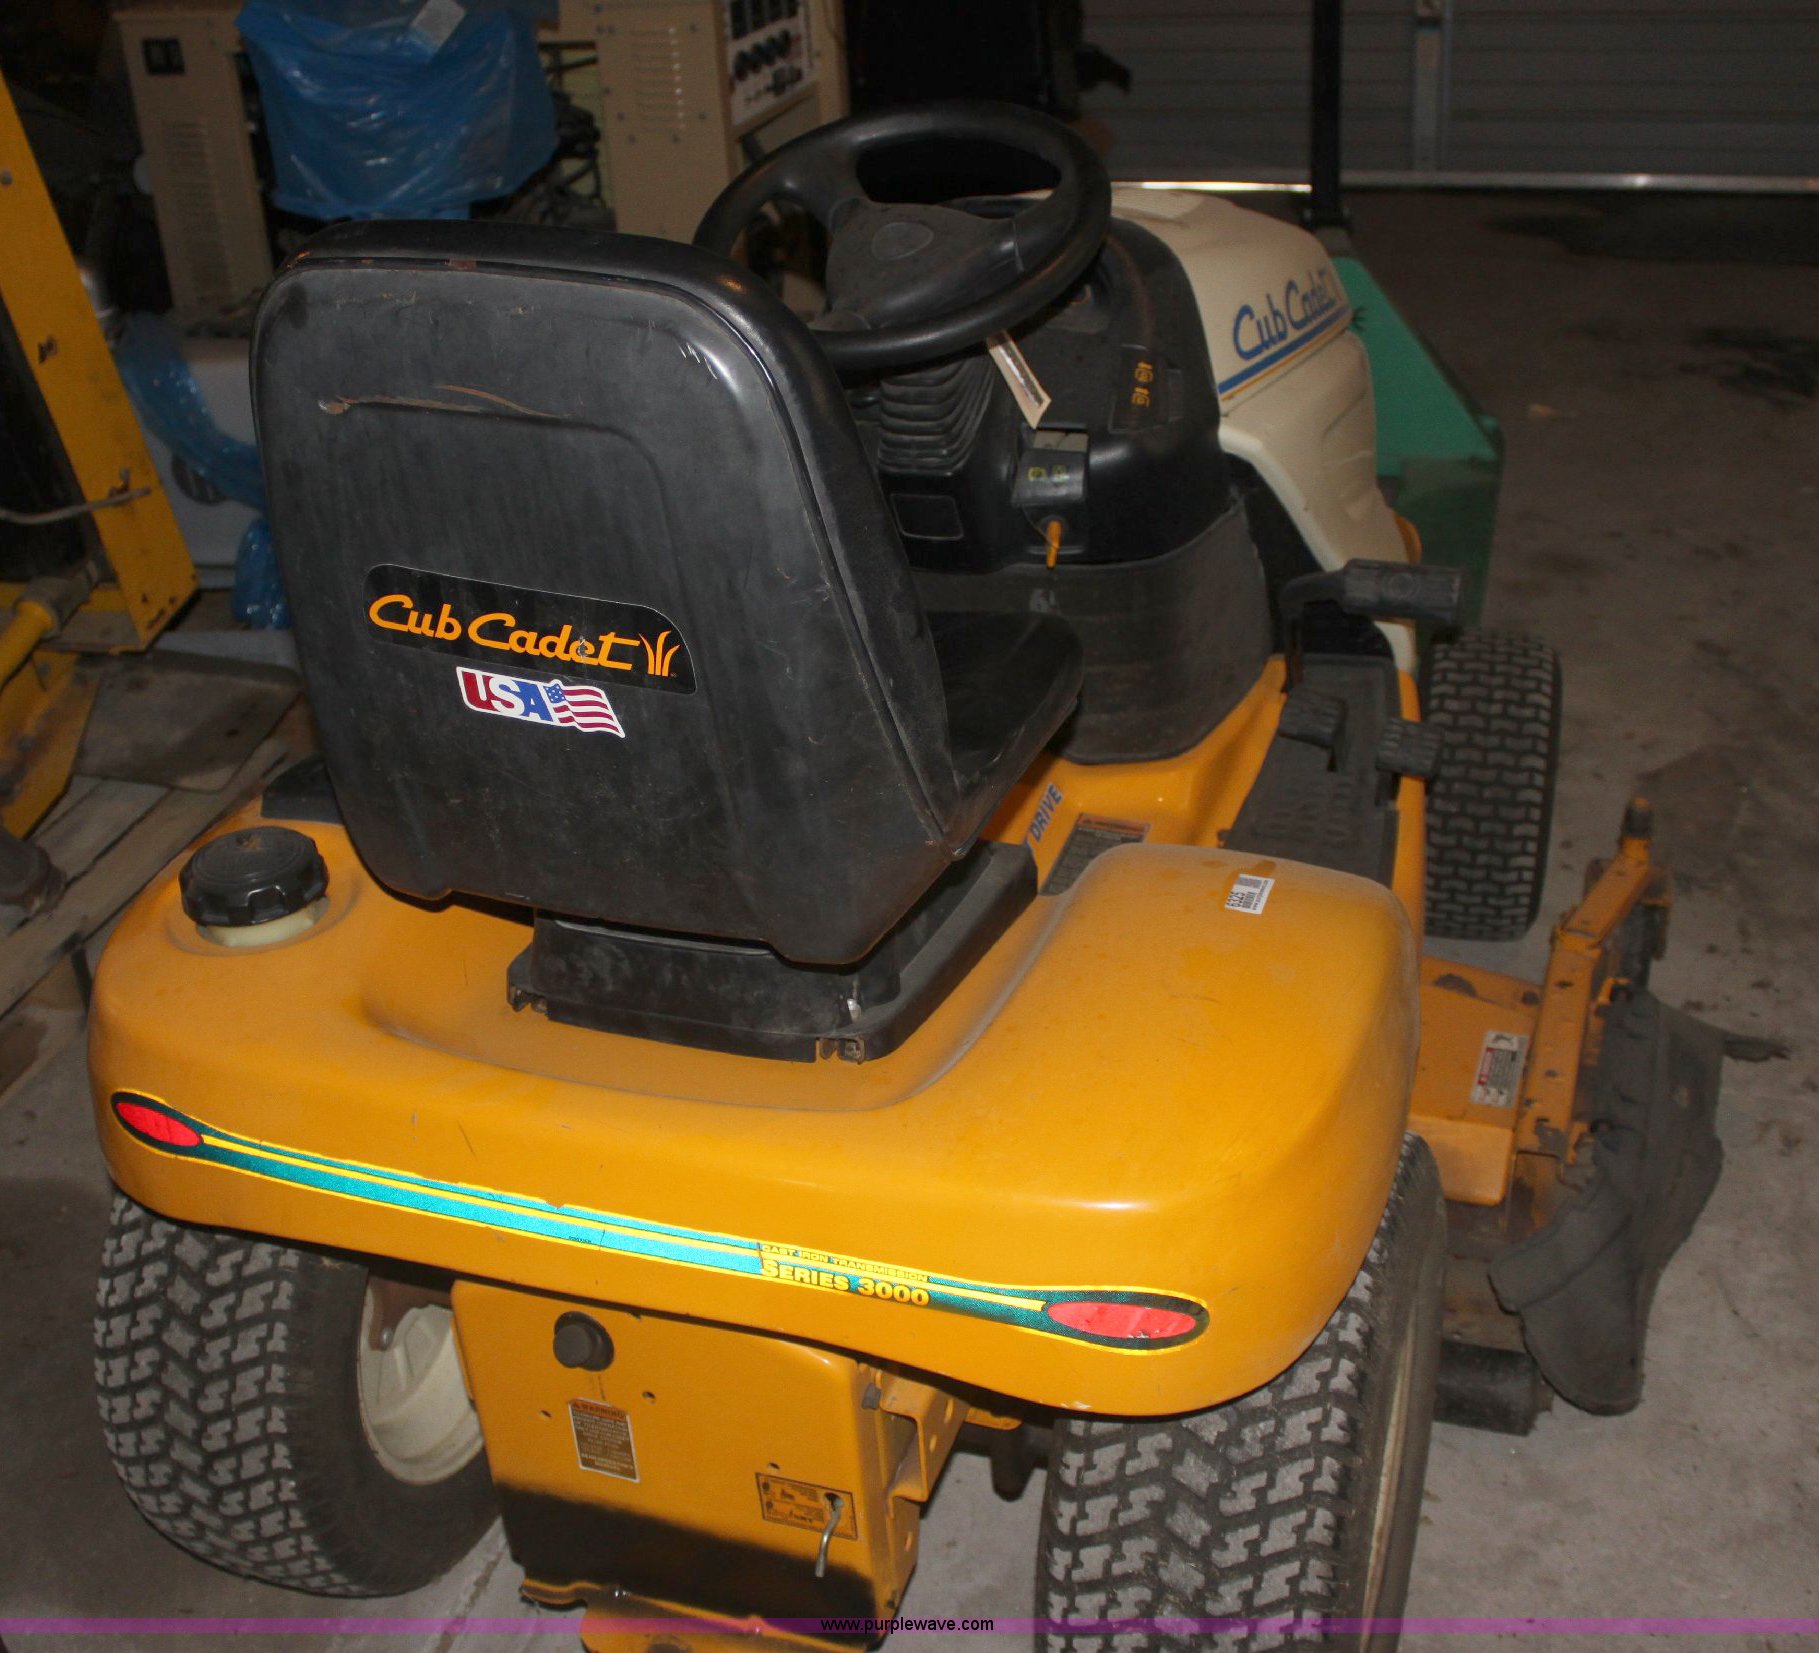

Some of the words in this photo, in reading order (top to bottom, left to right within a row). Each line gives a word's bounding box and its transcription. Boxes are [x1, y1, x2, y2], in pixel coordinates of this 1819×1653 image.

[1233, 293, 1287, 361] Cub
[368, 594, 462, 641] Cub
[467, 612, 641, 671] Cadet
[459, 669, 555, 722] USA
[1029, 783, 1063, 841] DRIVE
[762, 1257, 850, 1292] SERIES
[857, 1277, 930, 1306] 3000
[799, 1250, 829, 1263] IRON
[832, 1256, 928, 1283] TRANSMISSION
